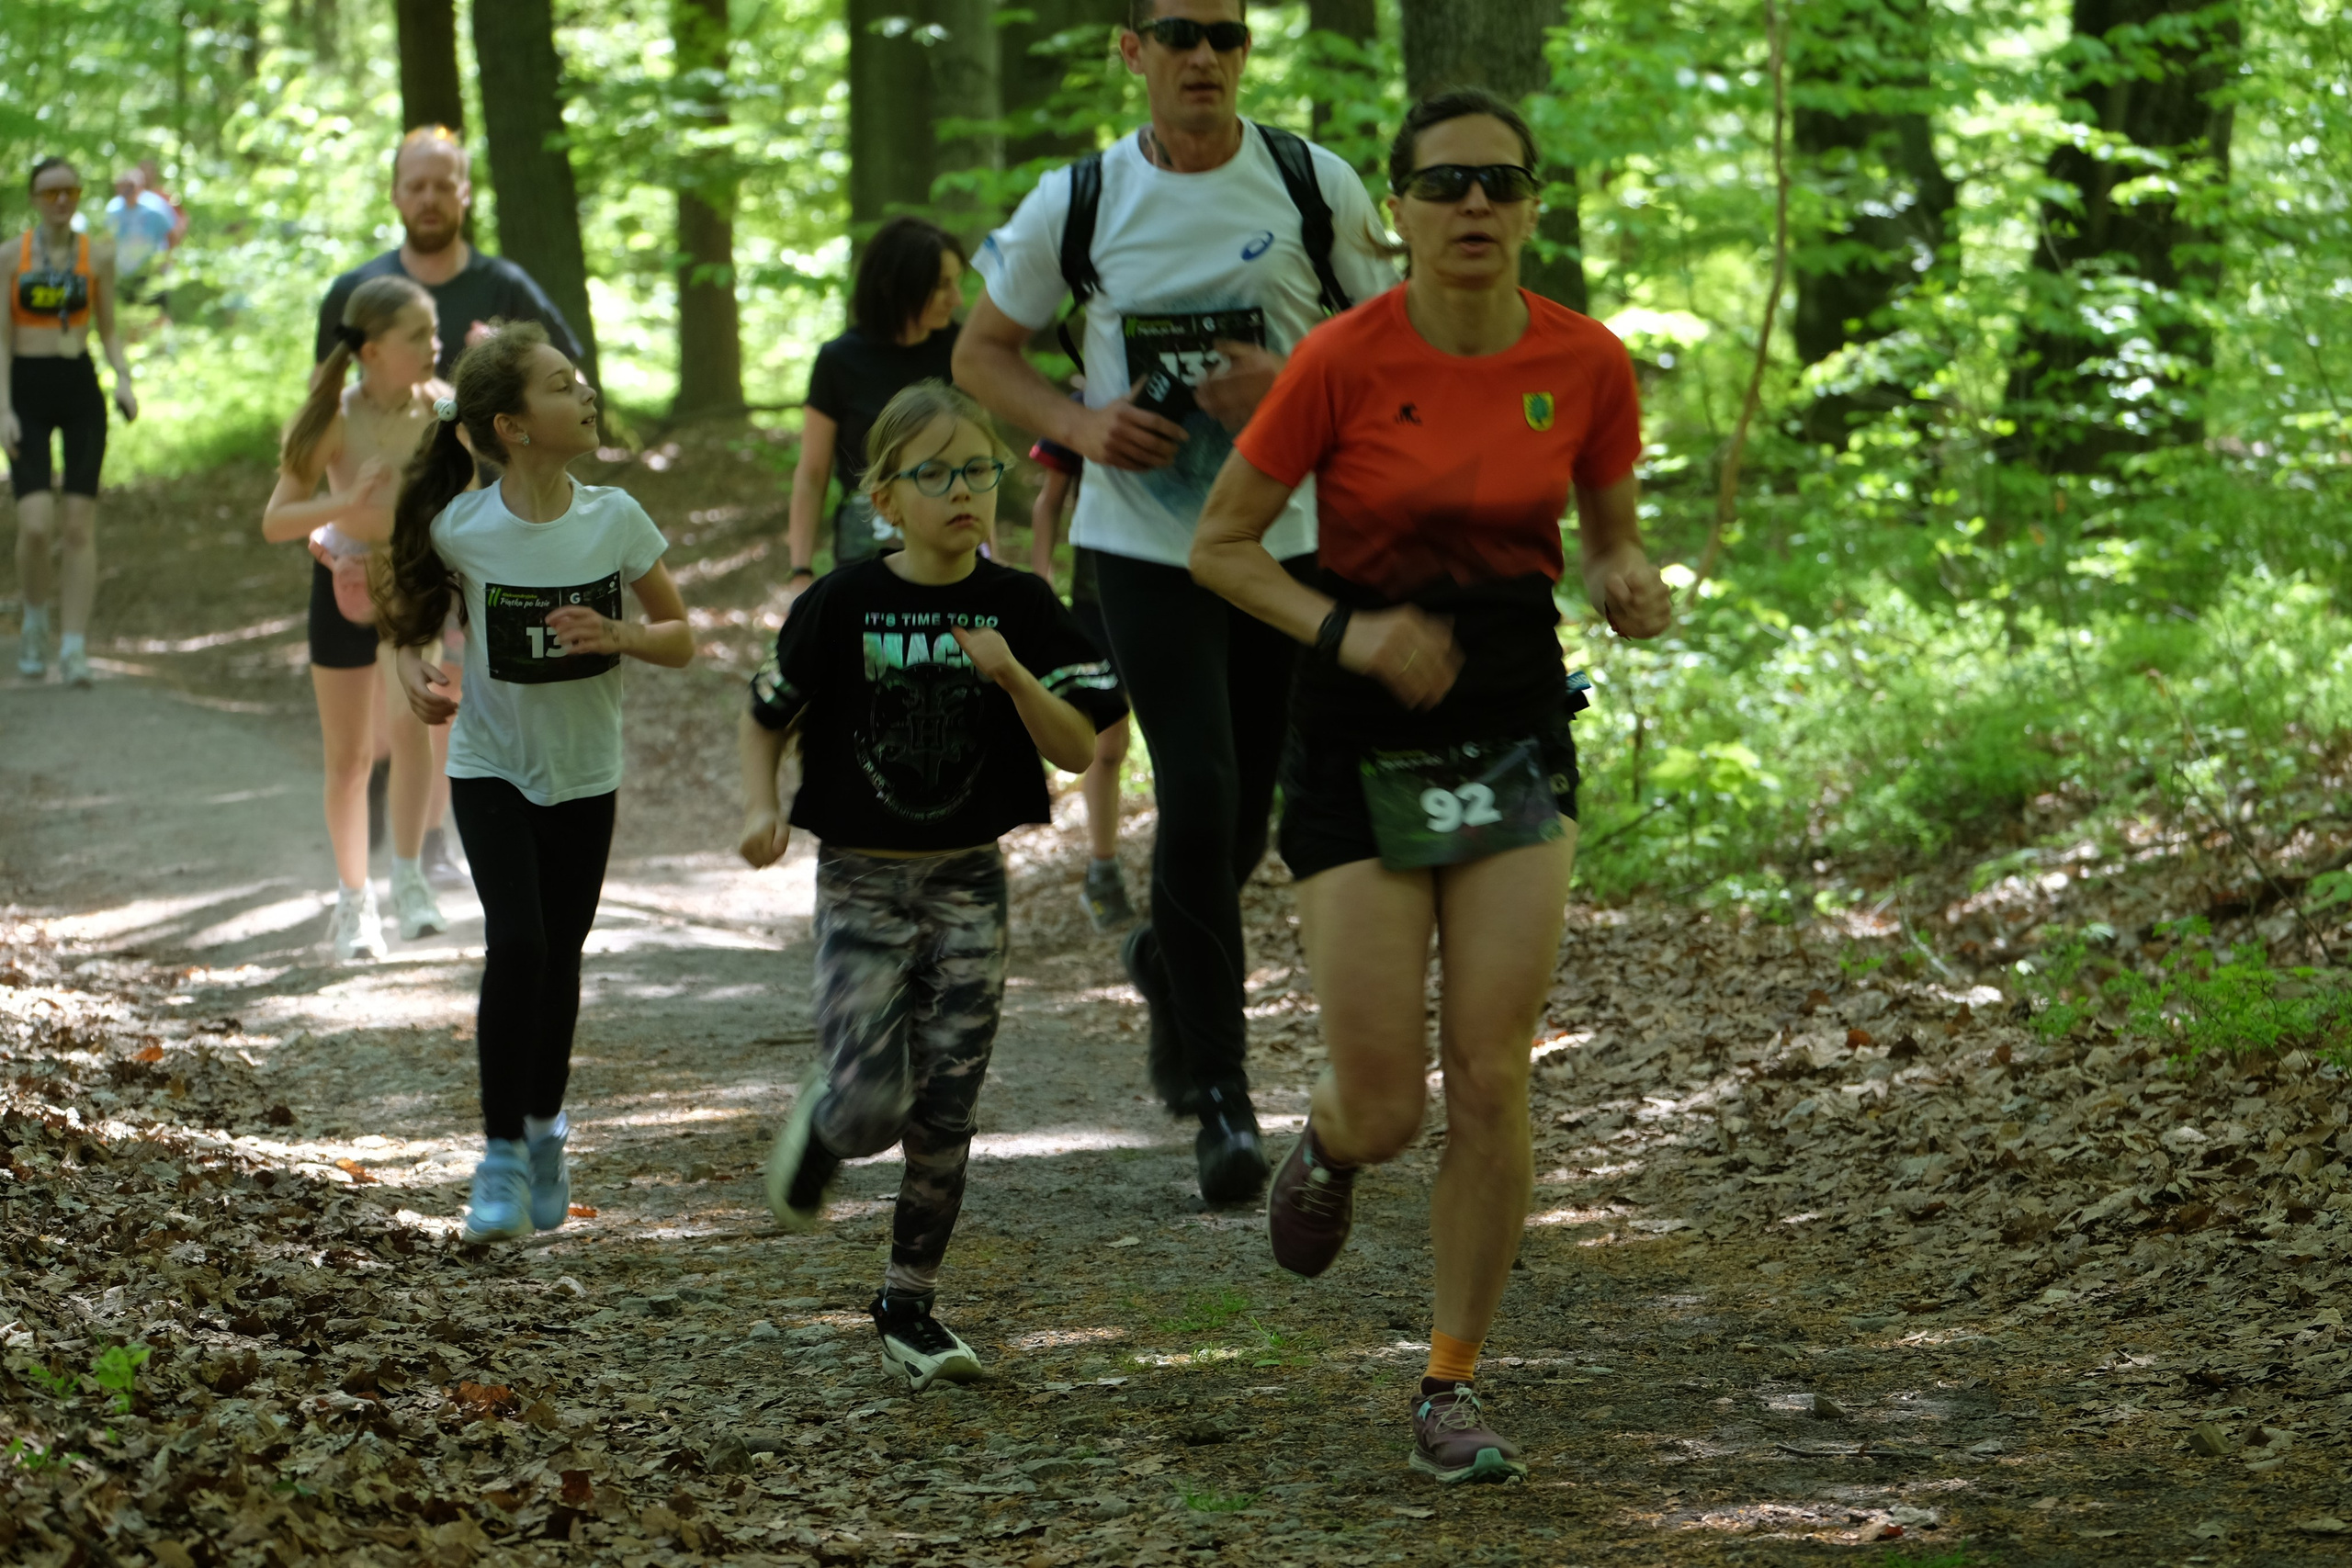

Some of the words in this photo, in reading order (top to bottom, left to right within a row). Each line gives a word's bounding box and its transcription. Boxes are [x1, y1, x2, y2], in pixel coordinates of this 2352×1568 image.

[523, 600, 535, 609] po
[534, 598, 550, 608] lesie
[865, 612, 896, 627] IT'S
[901, 612, 941, 626] TIME
[947, 613, 969, 626] TO
[975, 615, 999, 628] DO
[1419, 783, 1503, 833] 92
